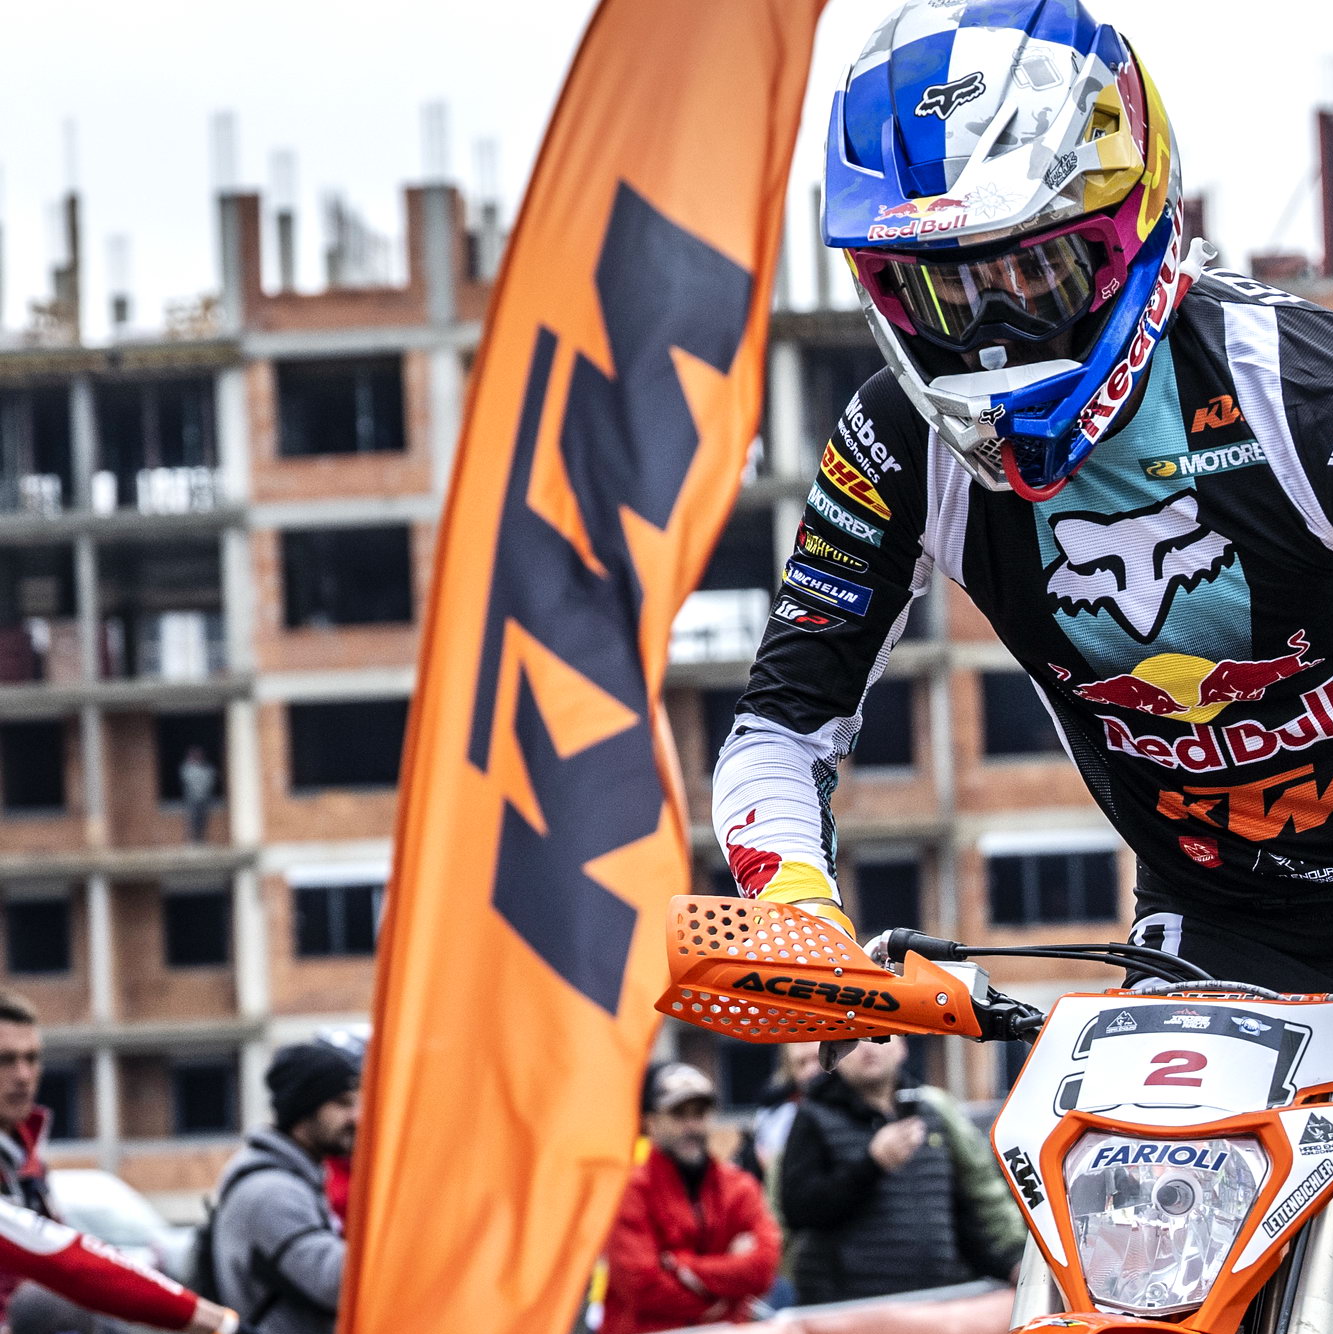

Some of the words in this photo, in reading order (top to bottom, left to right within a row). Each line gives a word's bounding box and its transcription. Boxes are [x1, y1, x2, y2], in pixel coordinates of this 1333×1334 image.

[868, 219, 917, 242] Red
[918, 213, 968, 235] Bull
[821, 444, 874, 507] DHL
[1179, 442, 1267, 475] MOTORE
[807, 485, 878, 544] MOTOREX
[467, 178, 754, 1018] KTM
[792, 568, 859, 603] MICHELIN
[731, 971, 900, 1013] ACERBIS
[1143, 1049, 1208, 1087] 2
[1003, 1146, 1045, 1210] KTM
[1091, 1145, 1228, 1173] FARIOLI
